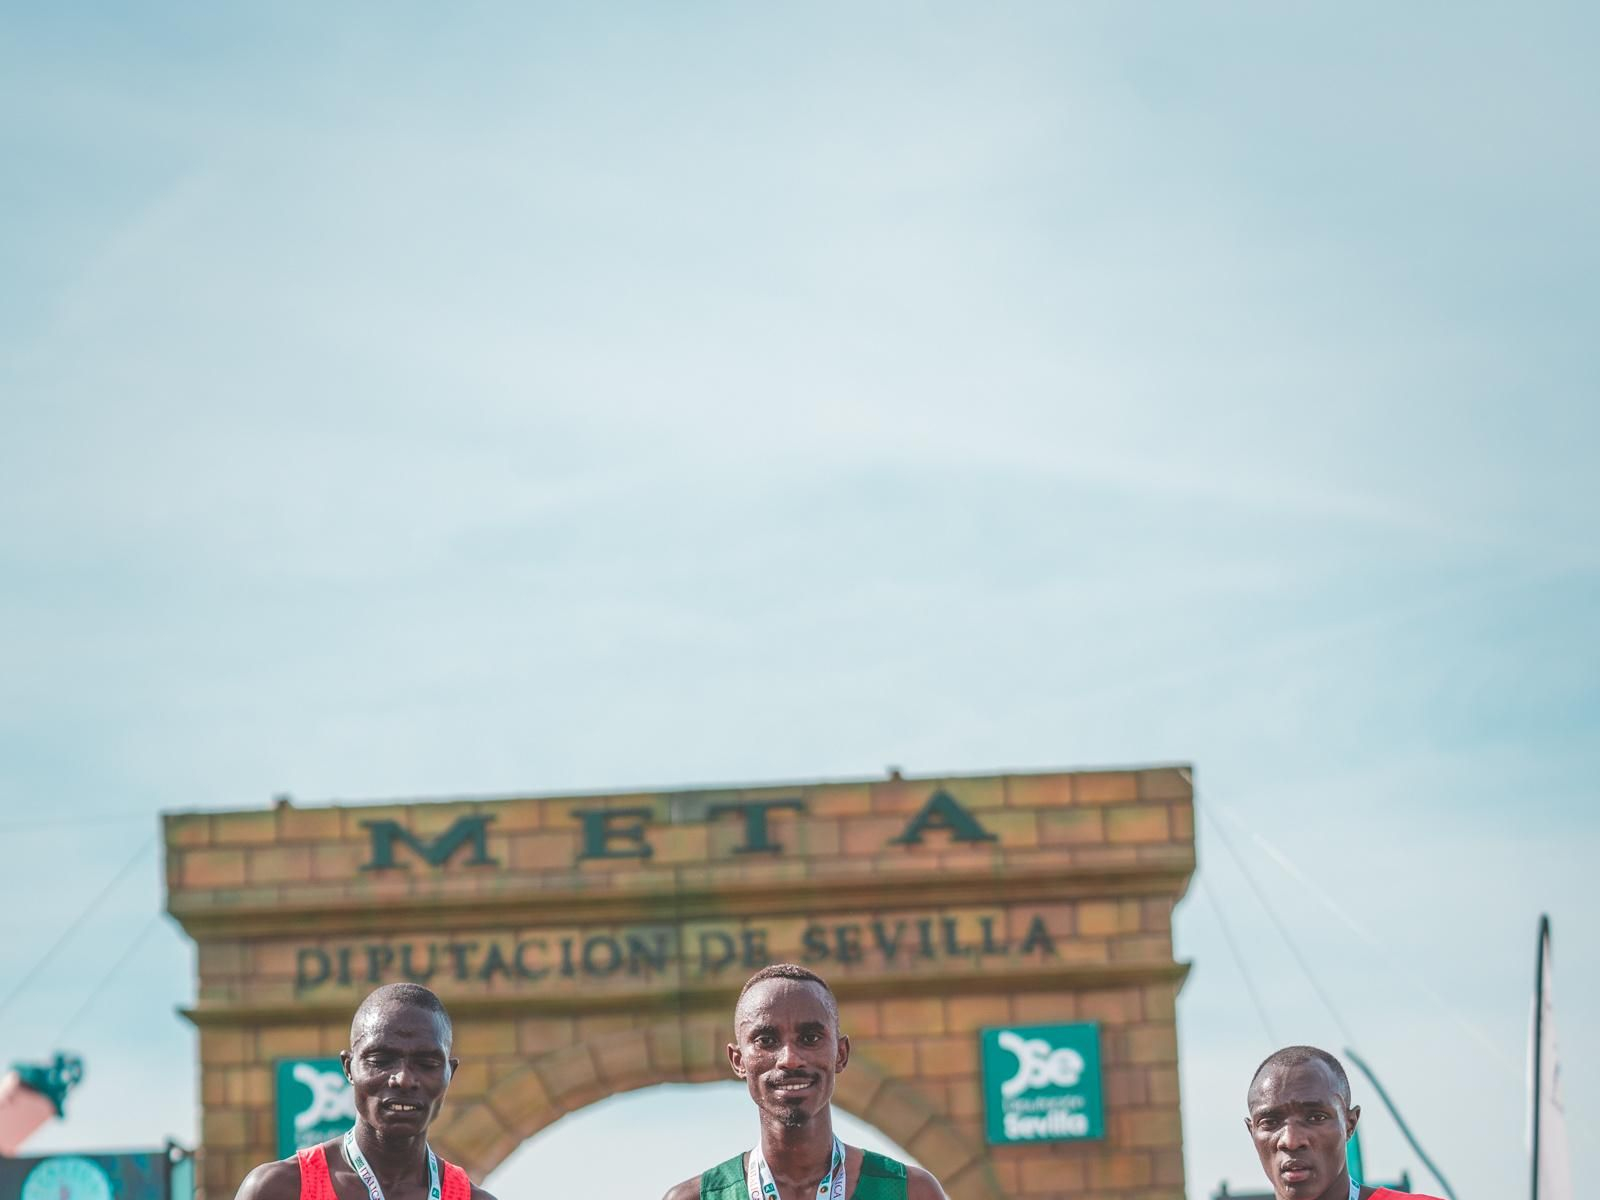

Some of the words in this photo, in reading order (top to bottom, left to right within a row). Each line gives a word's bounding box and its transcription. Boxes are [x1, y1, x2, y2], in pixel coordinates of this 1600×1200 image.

[359, 787, 999, 872] META
[296, 934, 669, 992] DIPUTACION
[699, 927, 769, 974] DE
[802, 915, 1063, 963] SEVILLA
[1003, 1109, 1088, 1139] Sevilla
